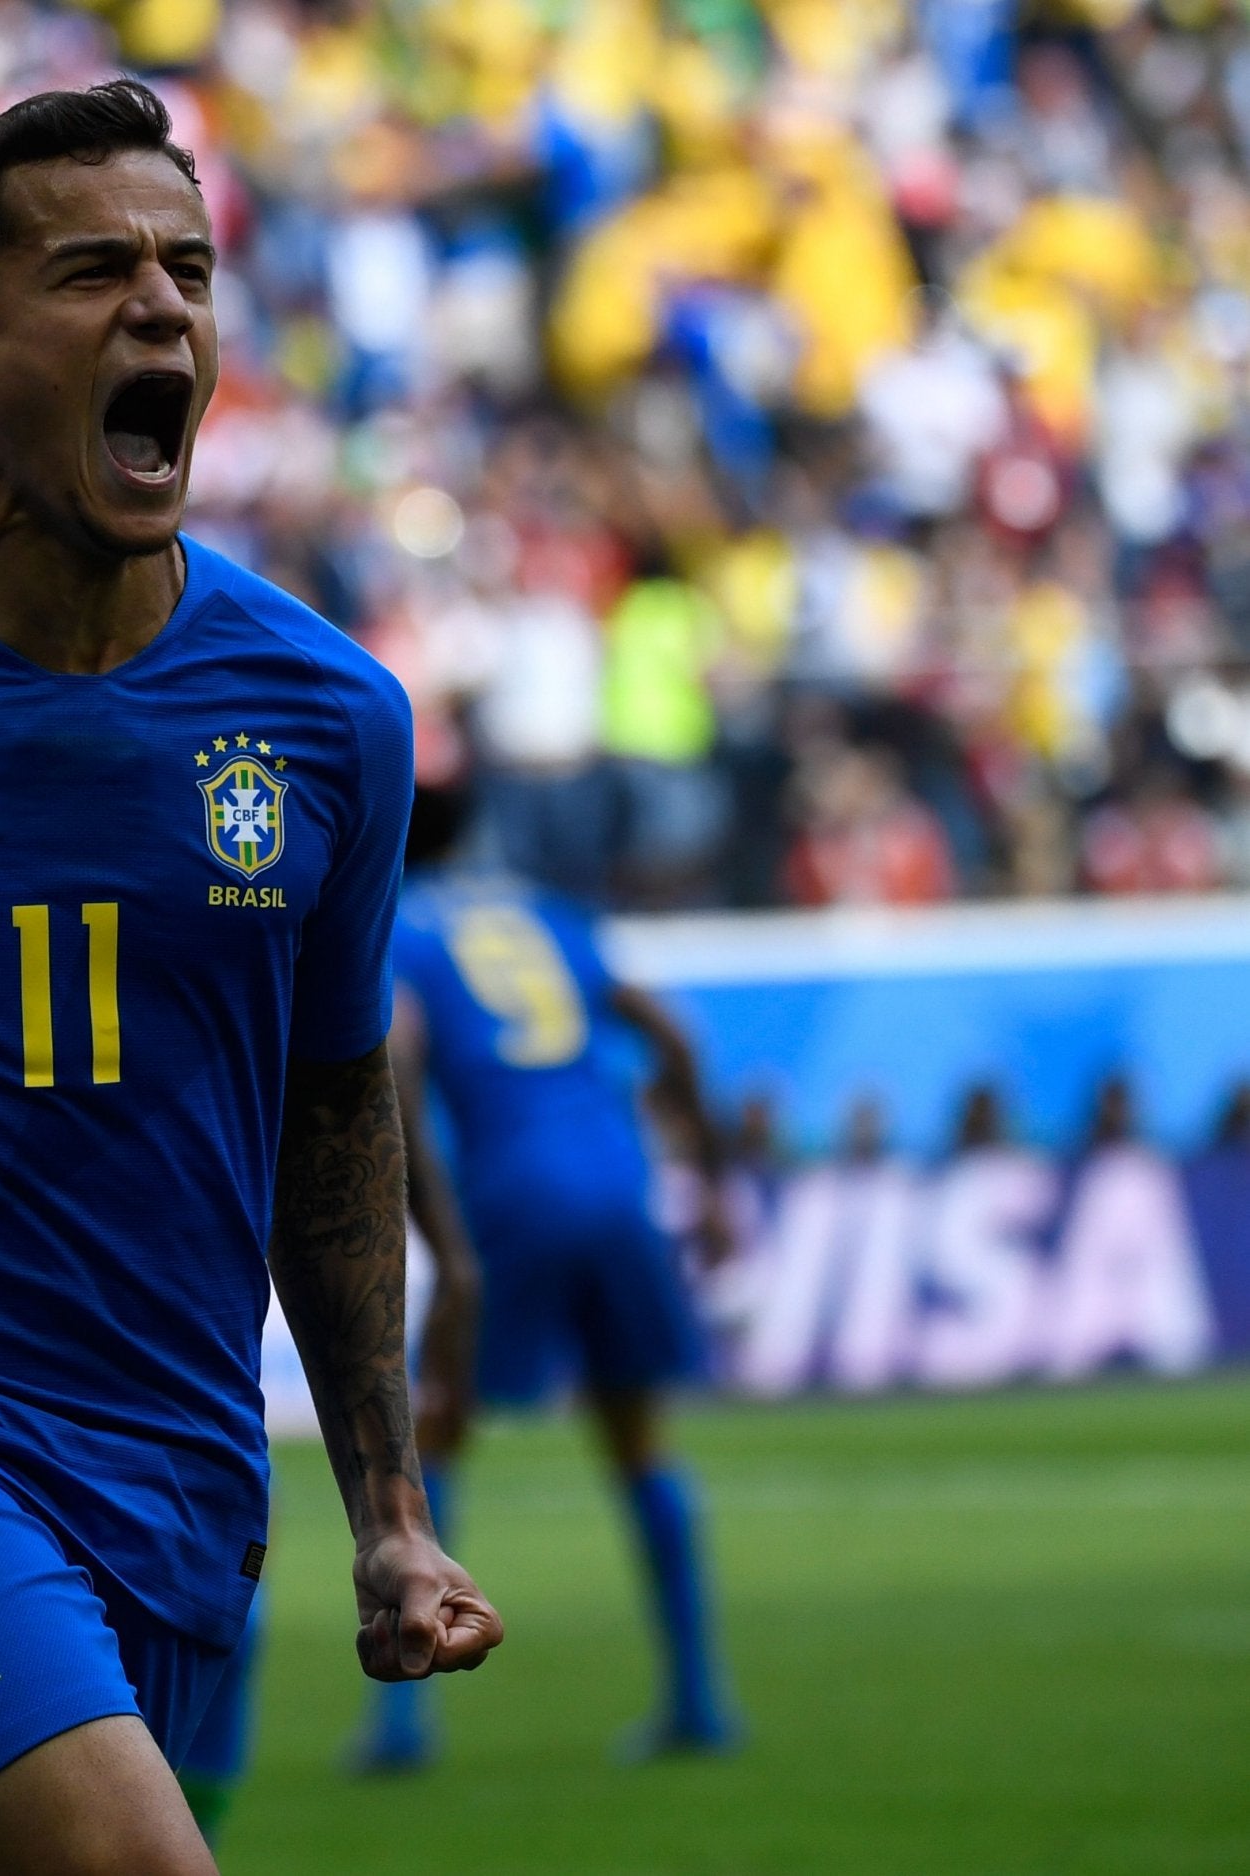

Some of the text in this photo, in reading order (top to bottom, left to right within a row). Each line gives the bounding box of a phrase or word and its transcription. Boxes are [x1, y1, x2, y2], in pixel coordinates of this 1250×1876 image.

[208, 885, 287, 908] BRASIL
[232, 809, 260, 822] CBF
[12, 902, 121, 1088] 11
[448, 904, 588, 1070] 9
[656, 1145, 1218, 1394] VISA
